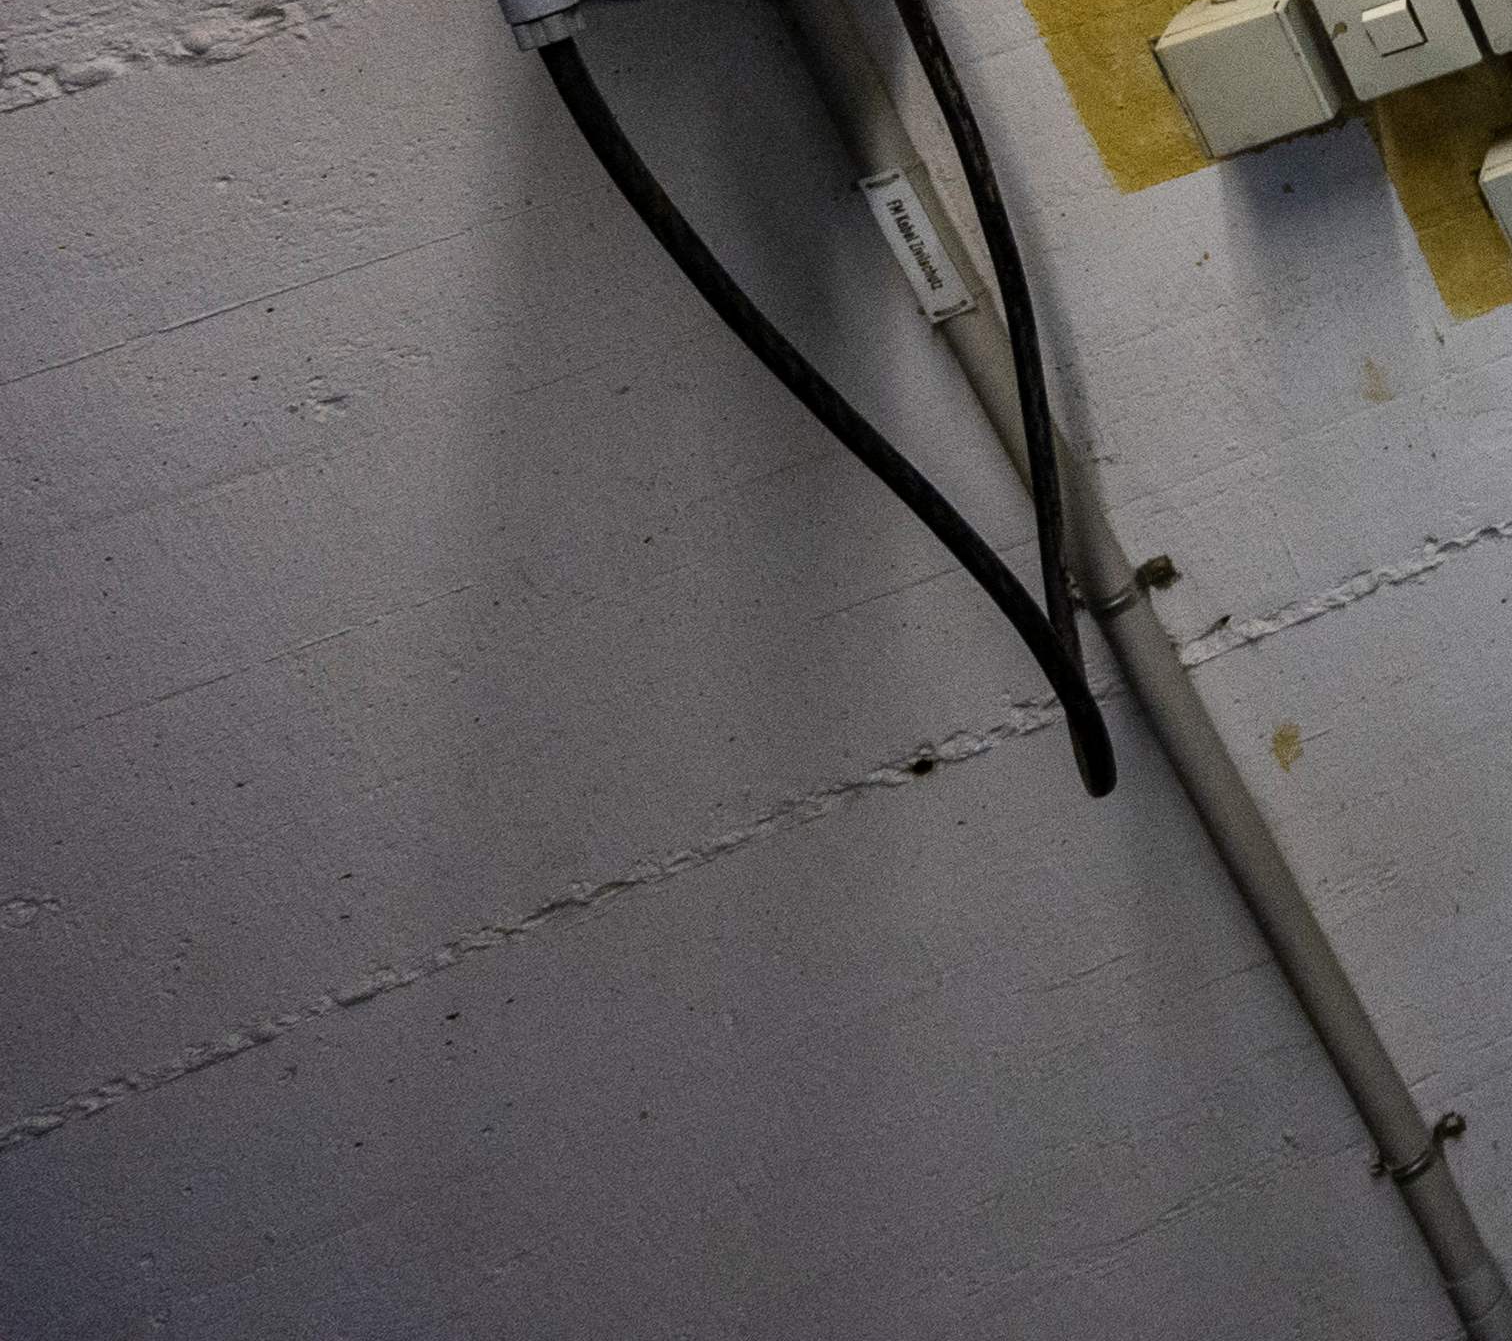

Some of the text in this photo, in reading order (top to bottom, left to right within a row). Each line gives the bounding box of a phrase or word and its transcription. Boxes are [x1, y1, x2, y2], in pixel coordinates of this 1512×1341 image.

[885, 198, 945, 291] FM Kabel Zivilschutz
